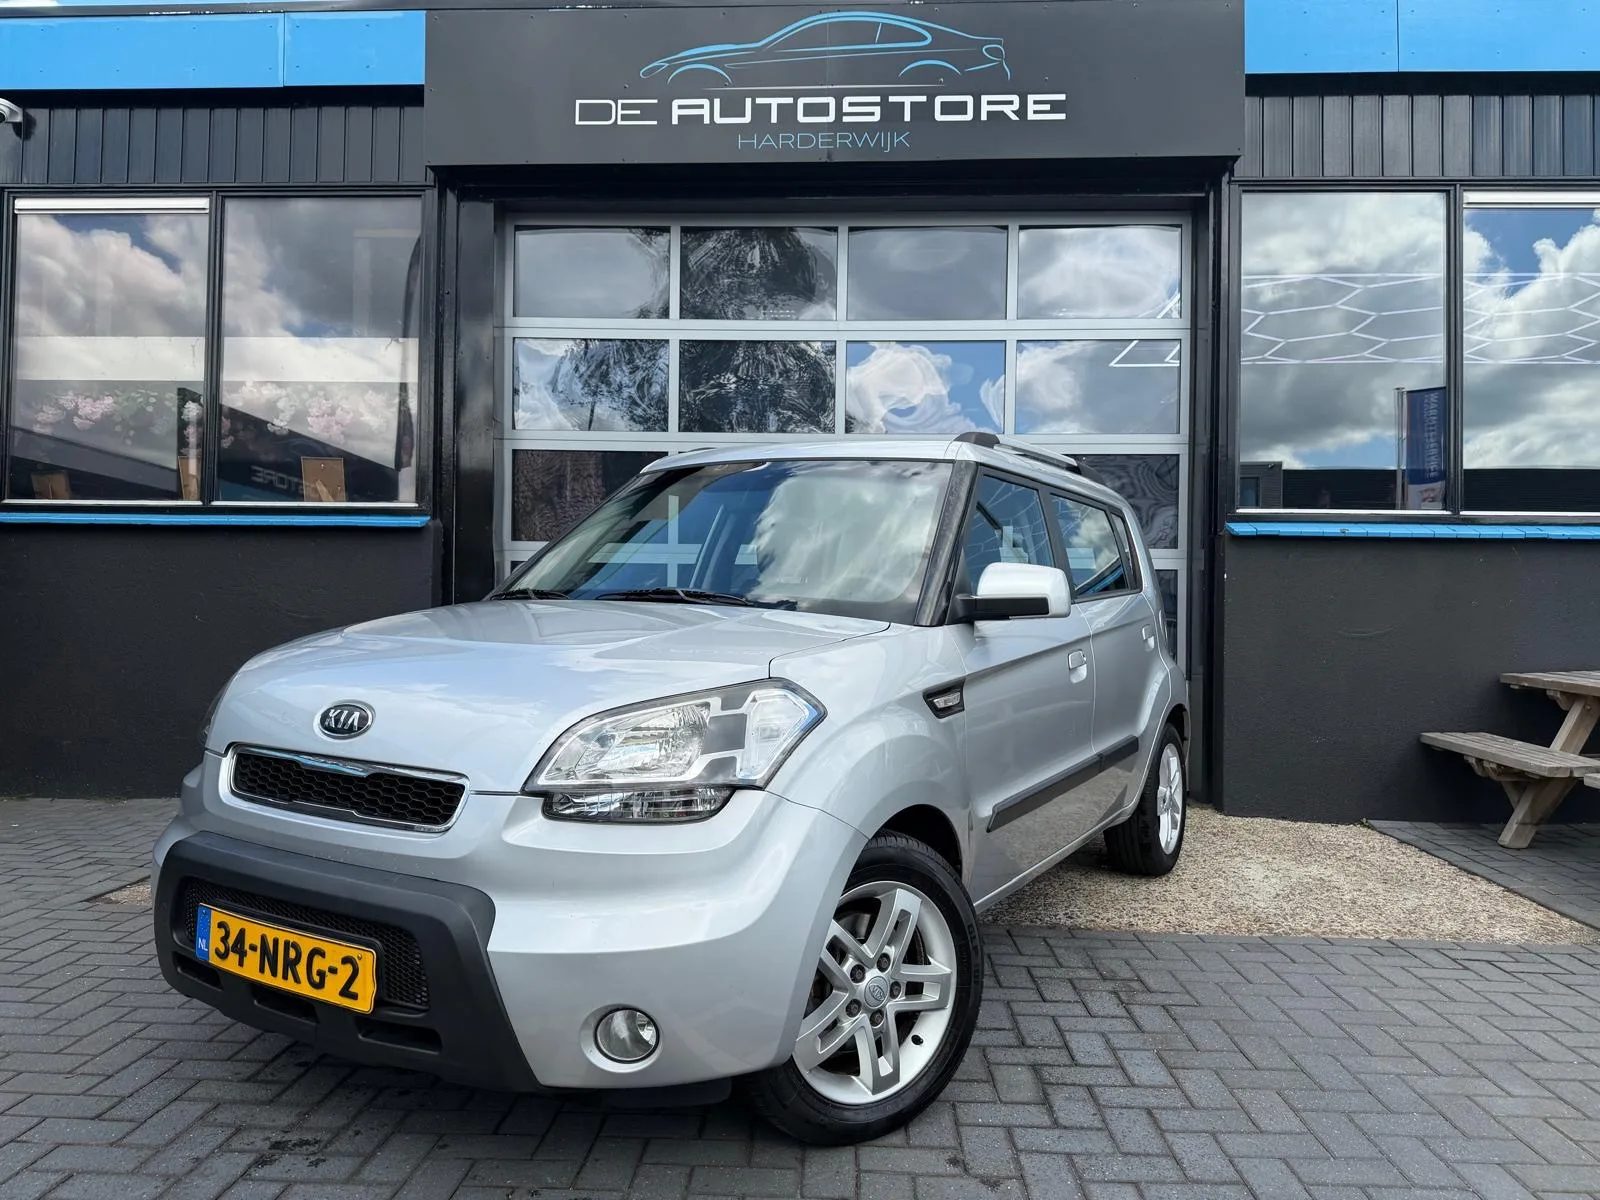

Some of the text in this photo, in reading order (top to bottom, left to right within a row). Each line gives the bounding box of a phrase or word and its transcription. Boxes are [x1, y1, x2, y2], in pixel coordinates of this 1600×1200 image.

[575, 94, 1067, 125] DE AUTOSTORE
[738, 131, 911, 152] HARDERWIJK
[325, 708, 361, 731] KIA
[198, 936, 209, 952] NL
[214, 920, 360, 1001] 34-NRG-2
